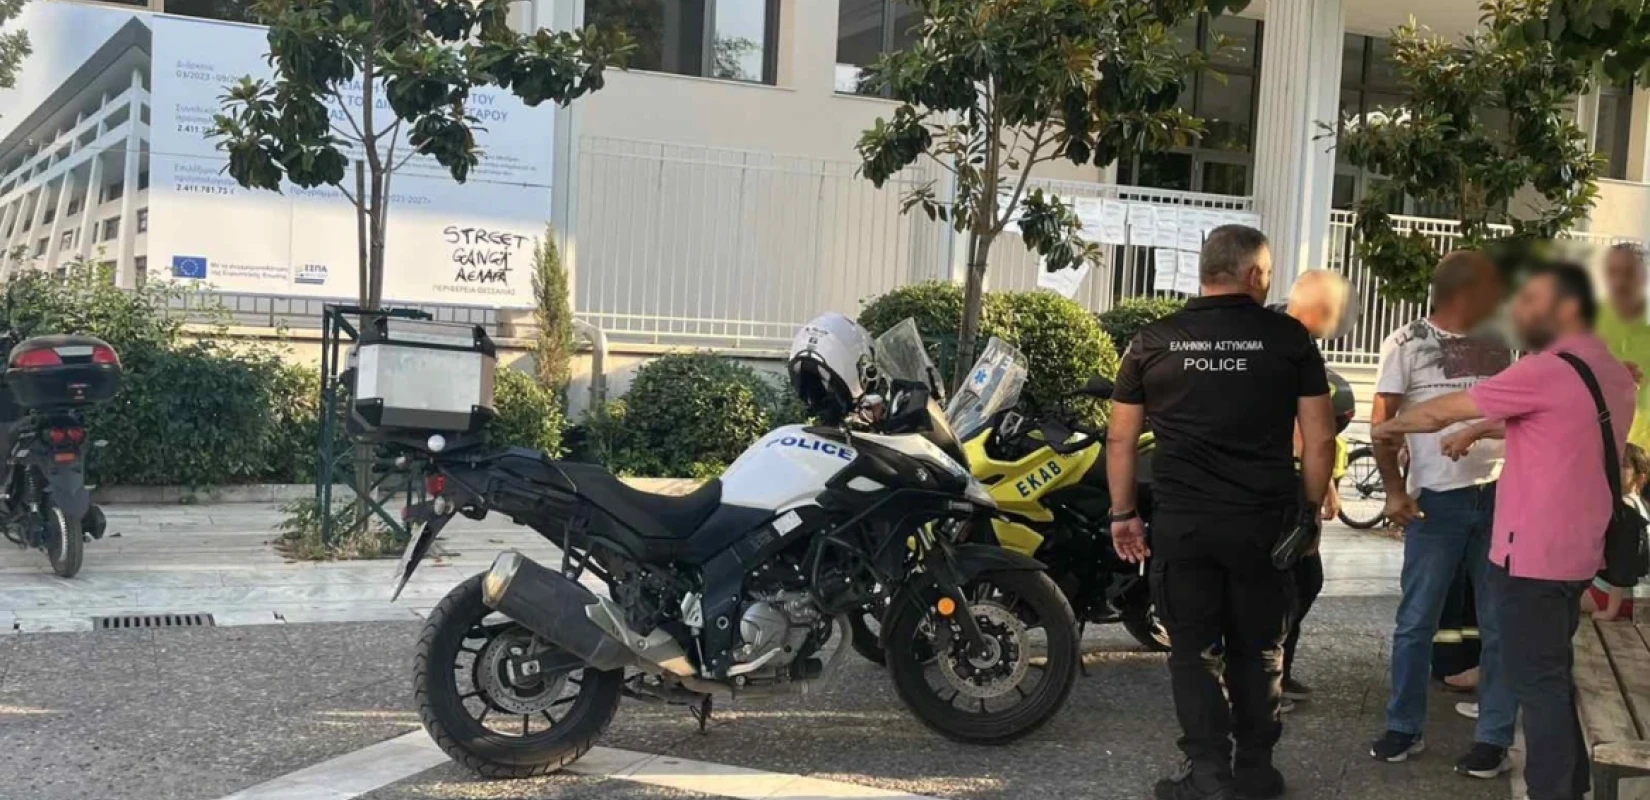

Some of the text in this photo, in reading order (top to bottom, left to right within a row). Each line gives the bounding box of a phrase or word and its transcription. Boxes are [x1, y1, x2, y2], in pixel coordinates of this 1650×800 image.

[471, 93, 495, 105] ΤΟΥ
[443, 226, 529, 249] STREET
[1169, 340, 1264, 352] ΕΛΛΗΝΙΚΗ ΑΣΤΥΝΟΜΙΑ
[1183, 357, 1248, 372] POLICE
[1016, 460, 1062, 498] ΕΚΑΒ
